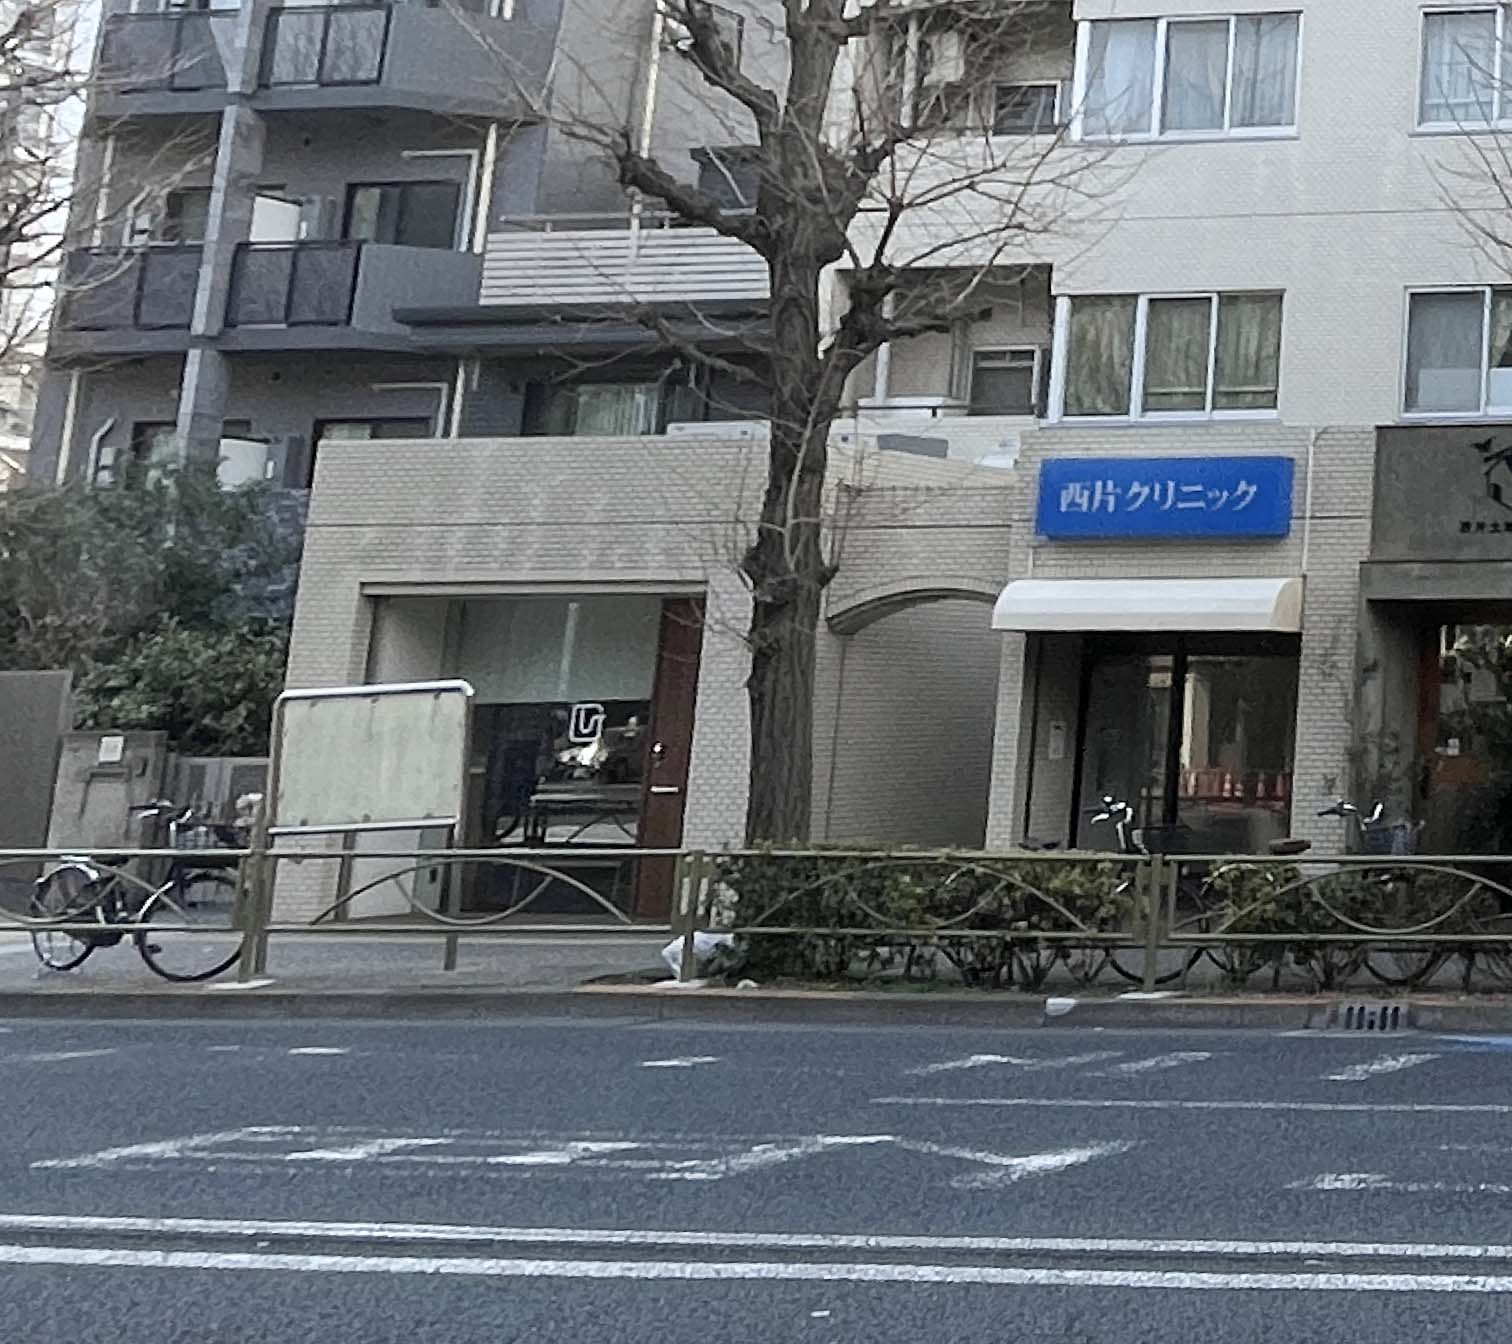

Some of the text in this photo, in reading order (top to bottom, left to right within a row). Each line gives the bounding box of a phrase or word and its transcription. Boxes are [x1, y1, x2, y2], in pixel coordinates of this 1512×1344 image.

[1060, 479, 1258, 513] 西片クリニック
